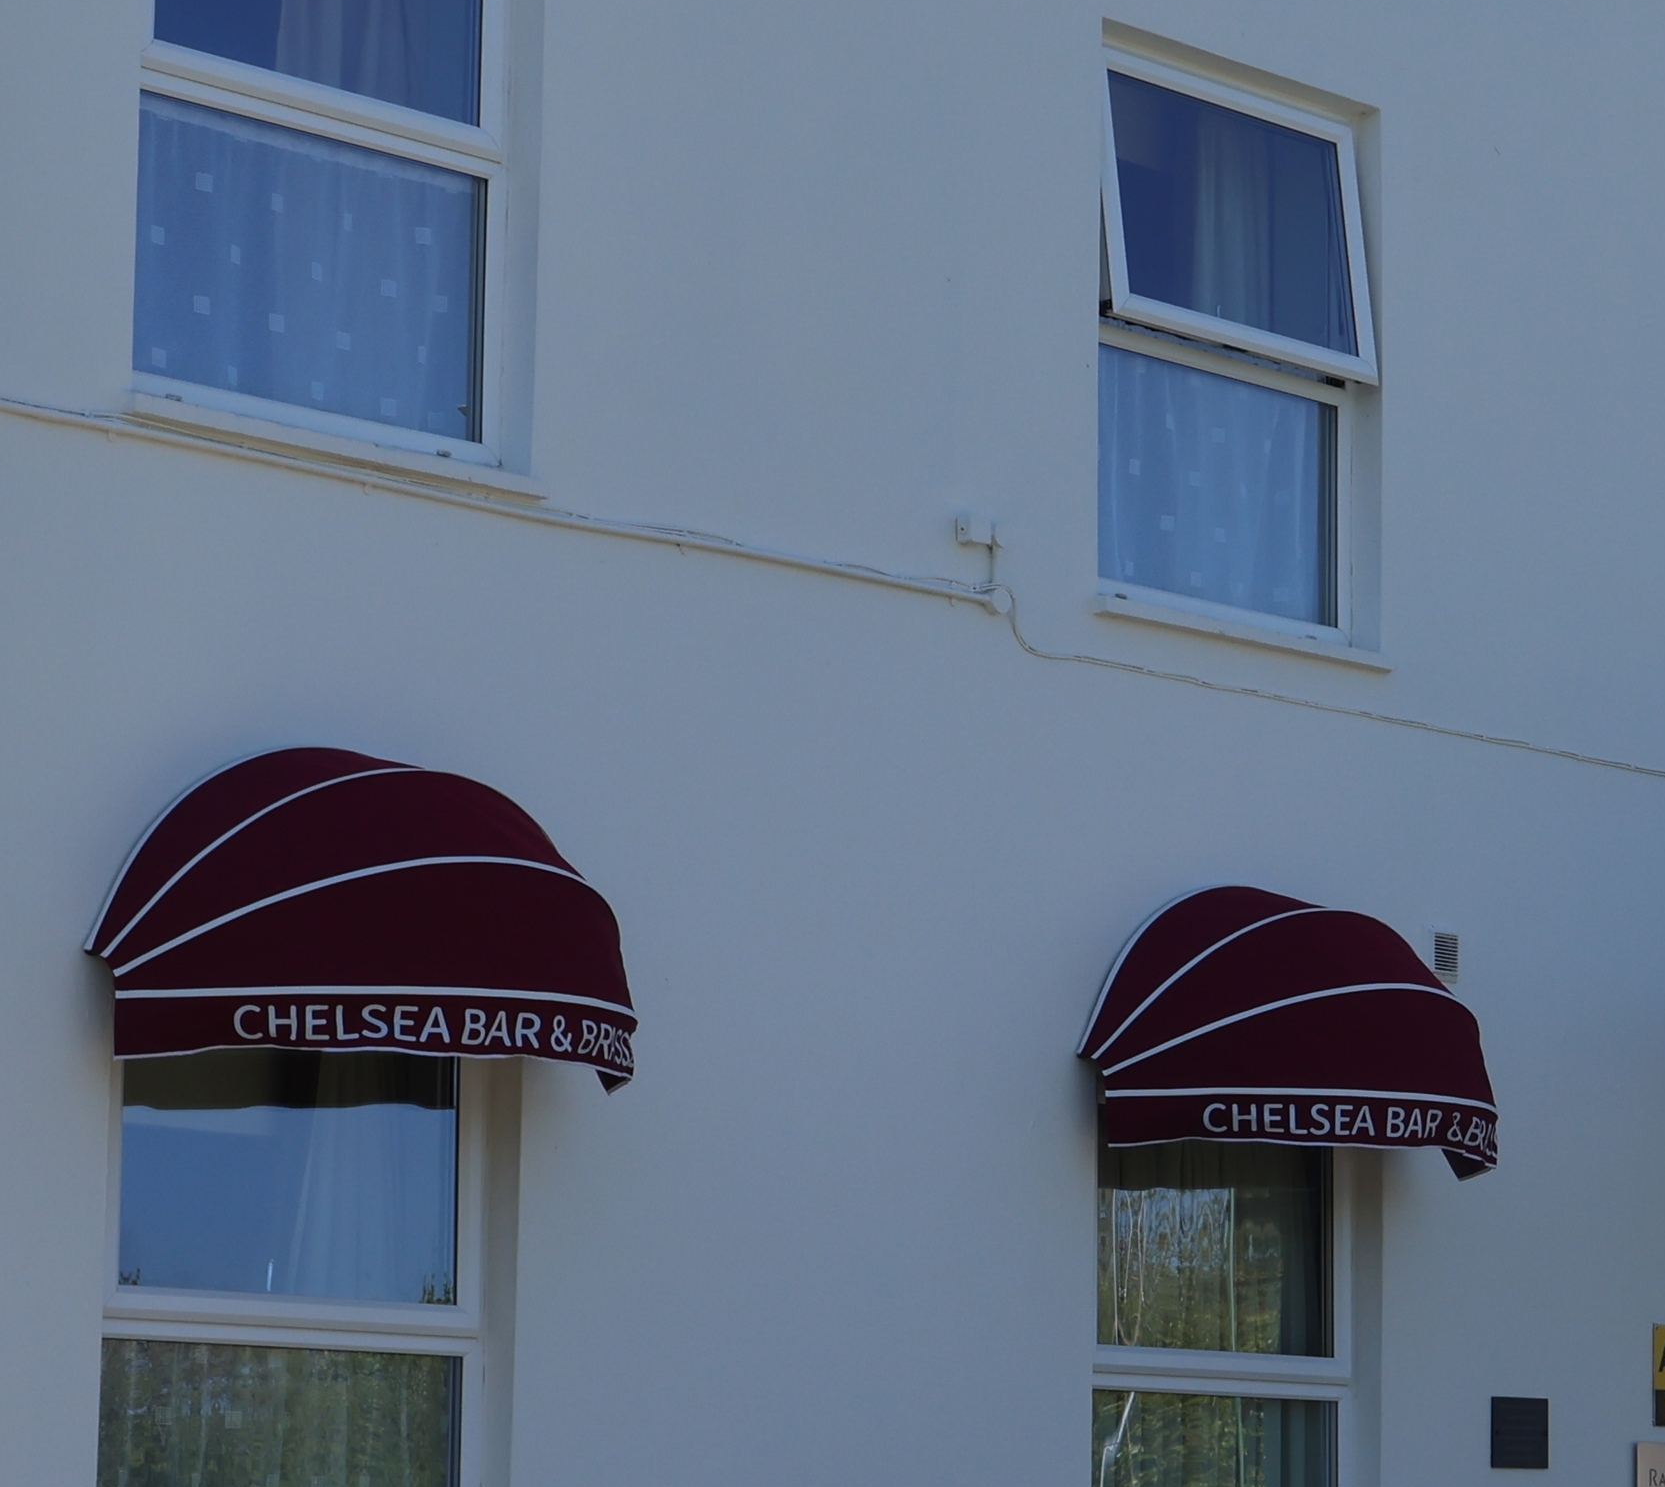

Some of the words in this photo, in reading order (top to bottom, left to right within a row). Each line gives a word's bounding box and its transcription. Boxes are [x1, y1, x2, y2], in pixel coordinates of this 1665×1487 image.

[232, 1003, 451, 1044] CHELSEA
[460, 1009, 542, 1050] BAR
[550, 1015, 573, 1053] &
[1202, 1102, 1376, 1136] CHELSEA
[1386, 1106, 1443, 1139] BAR
[1446, 1111, 1463, 1142] &
